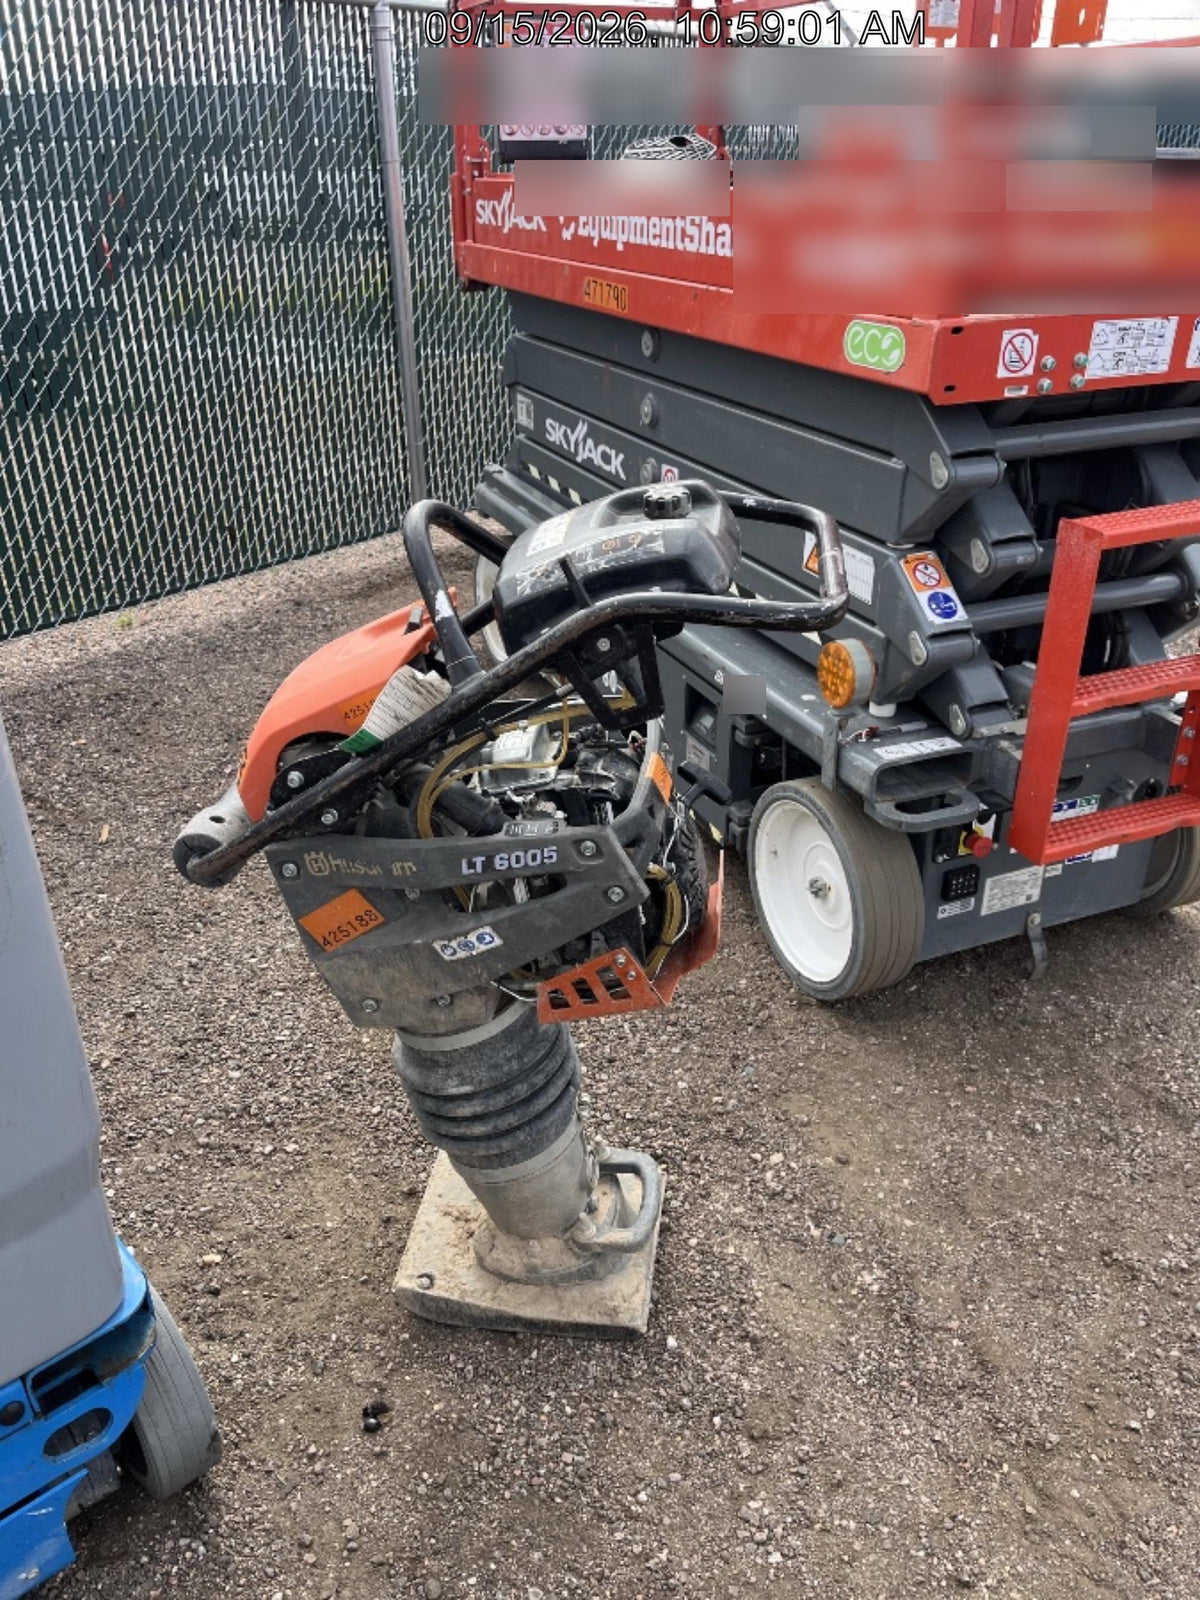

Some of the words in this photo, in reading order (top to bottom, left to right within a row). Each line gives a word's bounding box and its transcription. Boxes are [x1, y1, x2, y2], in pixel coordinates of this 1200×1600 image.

[475, 185, 548, 235] SKYJACK
[577, 214, 733, 258] EquipmentSha
[584, 278, 627, 312] 471790
[545, 419, 627, 480] SKYJACK
[461, 855, 486, 876] LT
[493, 845, 558, 871] 6005
[321, 909, 379, 948] 425188
